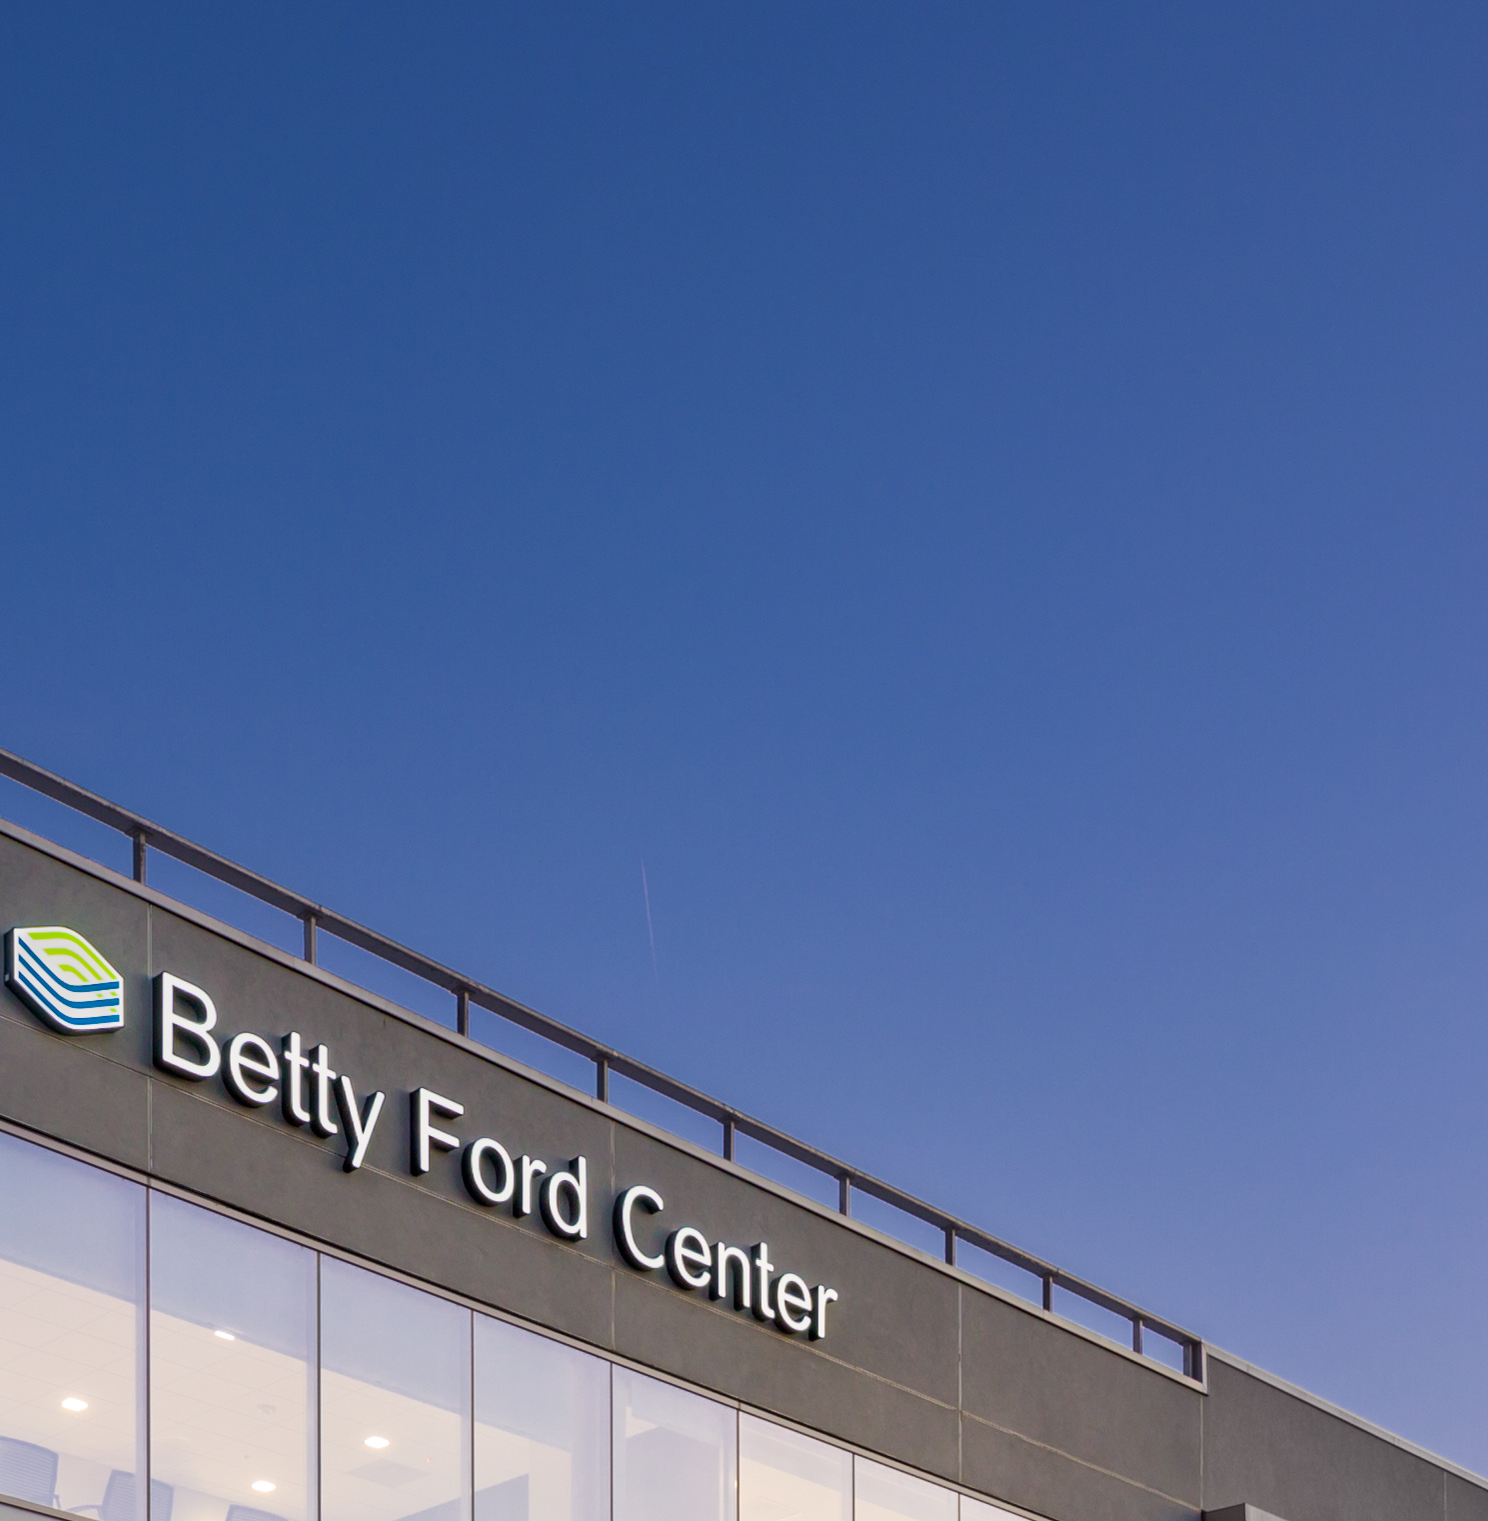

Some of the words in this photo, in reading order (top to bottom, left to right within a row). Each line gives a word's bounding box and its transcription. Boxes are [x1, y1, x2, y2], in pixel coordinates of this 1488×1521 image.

[156, 971, 385, 1170] Betty
[416, 1087, 587, 1241] Ford
[619, 1185, 838, 1340] Center
